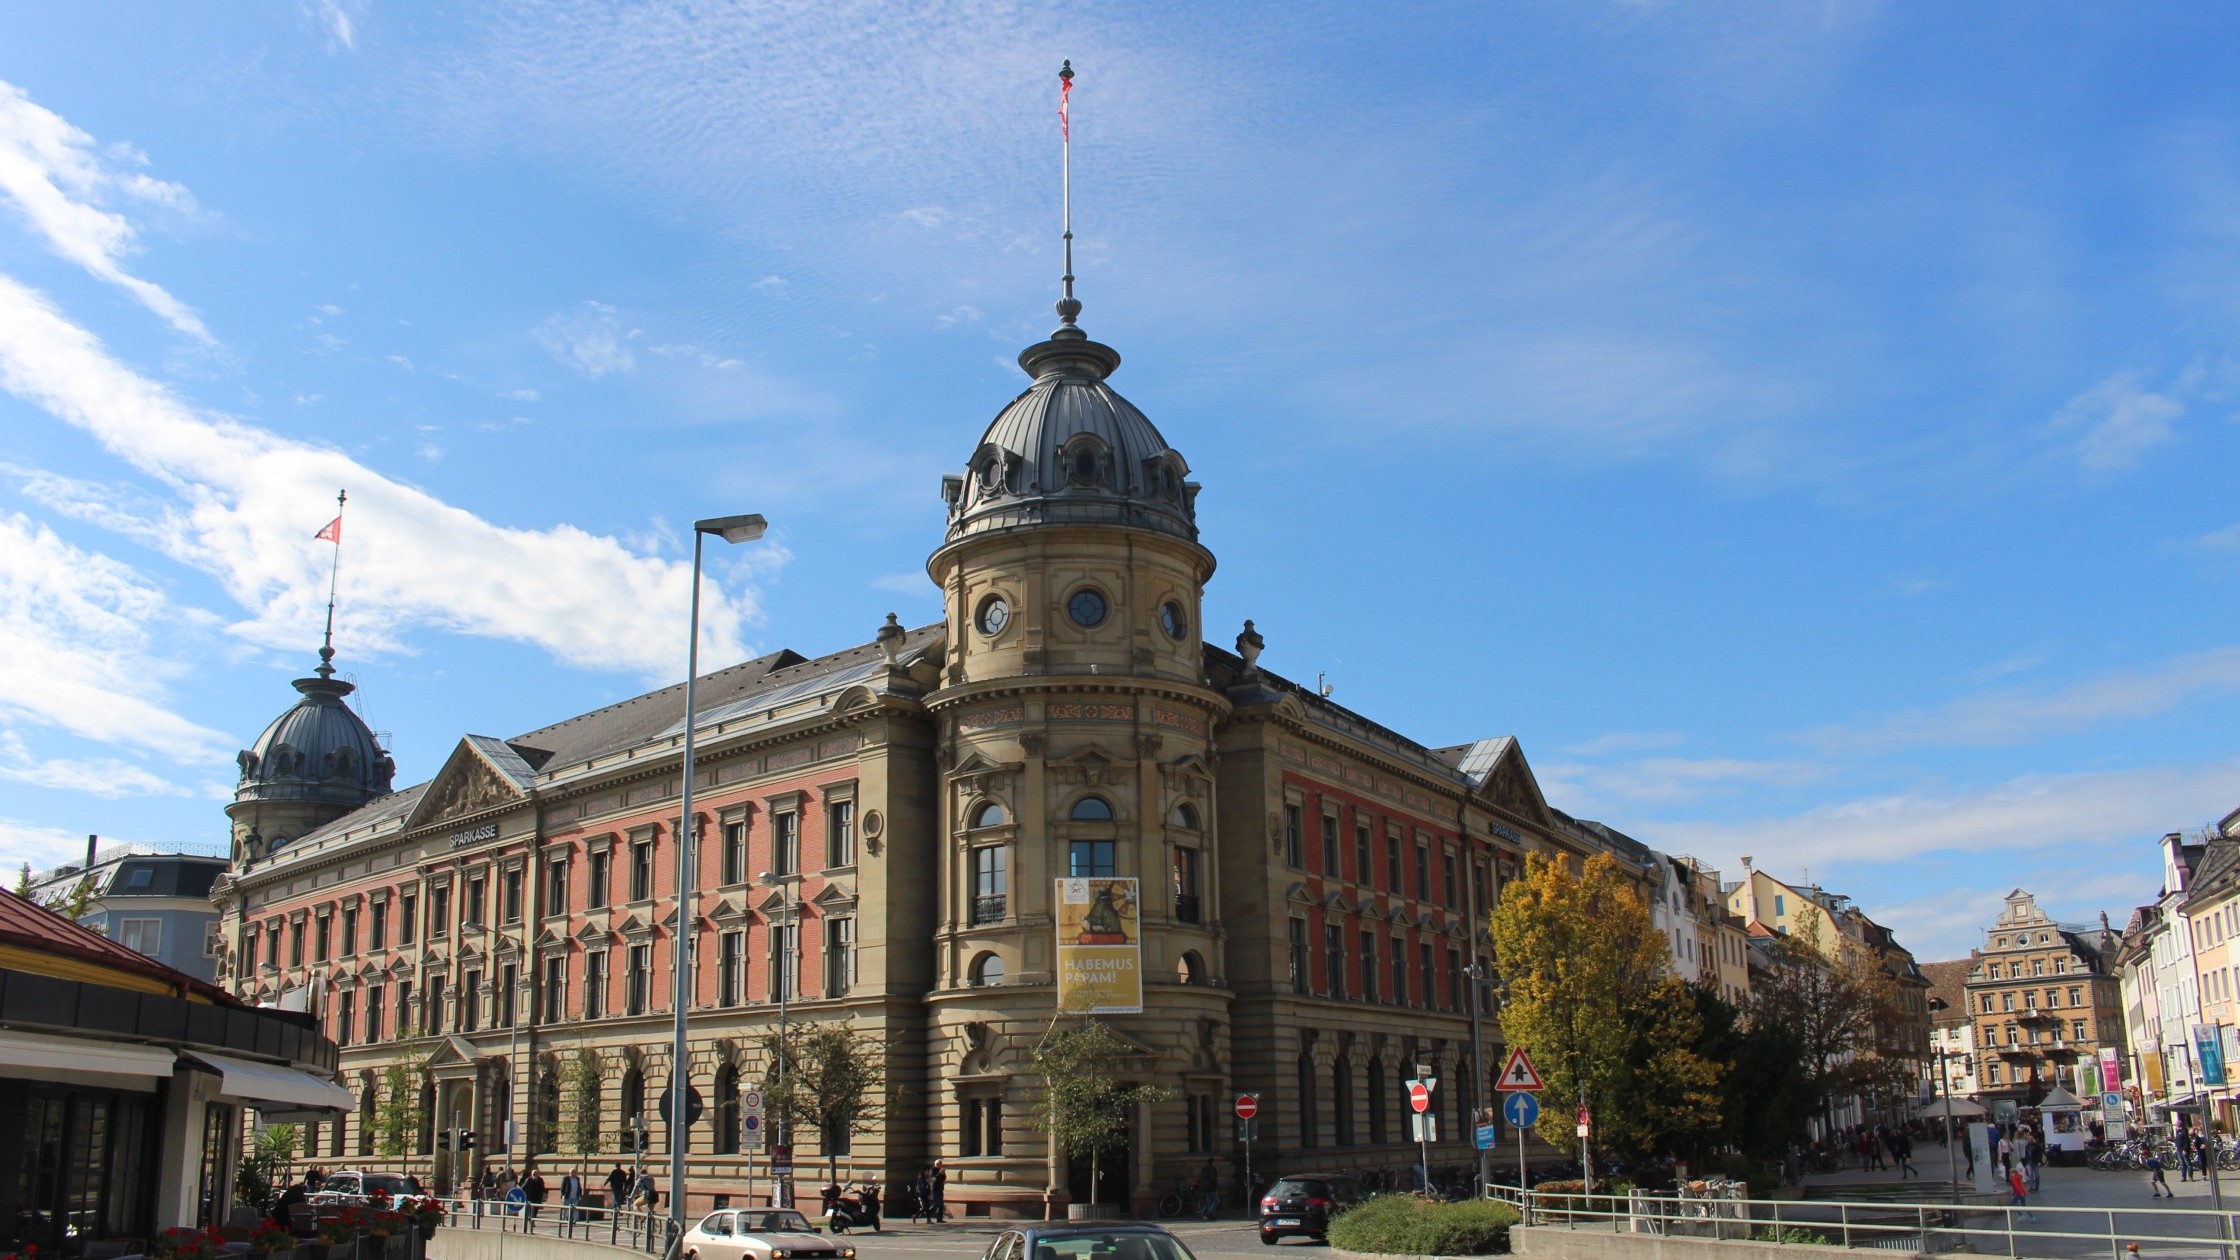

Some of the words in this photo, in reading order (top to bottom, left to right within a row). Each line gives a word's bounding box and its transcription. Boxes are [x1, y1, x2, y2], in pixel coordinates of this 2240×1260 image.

[449, 824, 496, 847] SPARKASSE
[1065, 958, 1134, 970] HABEMUS
[1065, 971, 1116, 984] PAPAM!
